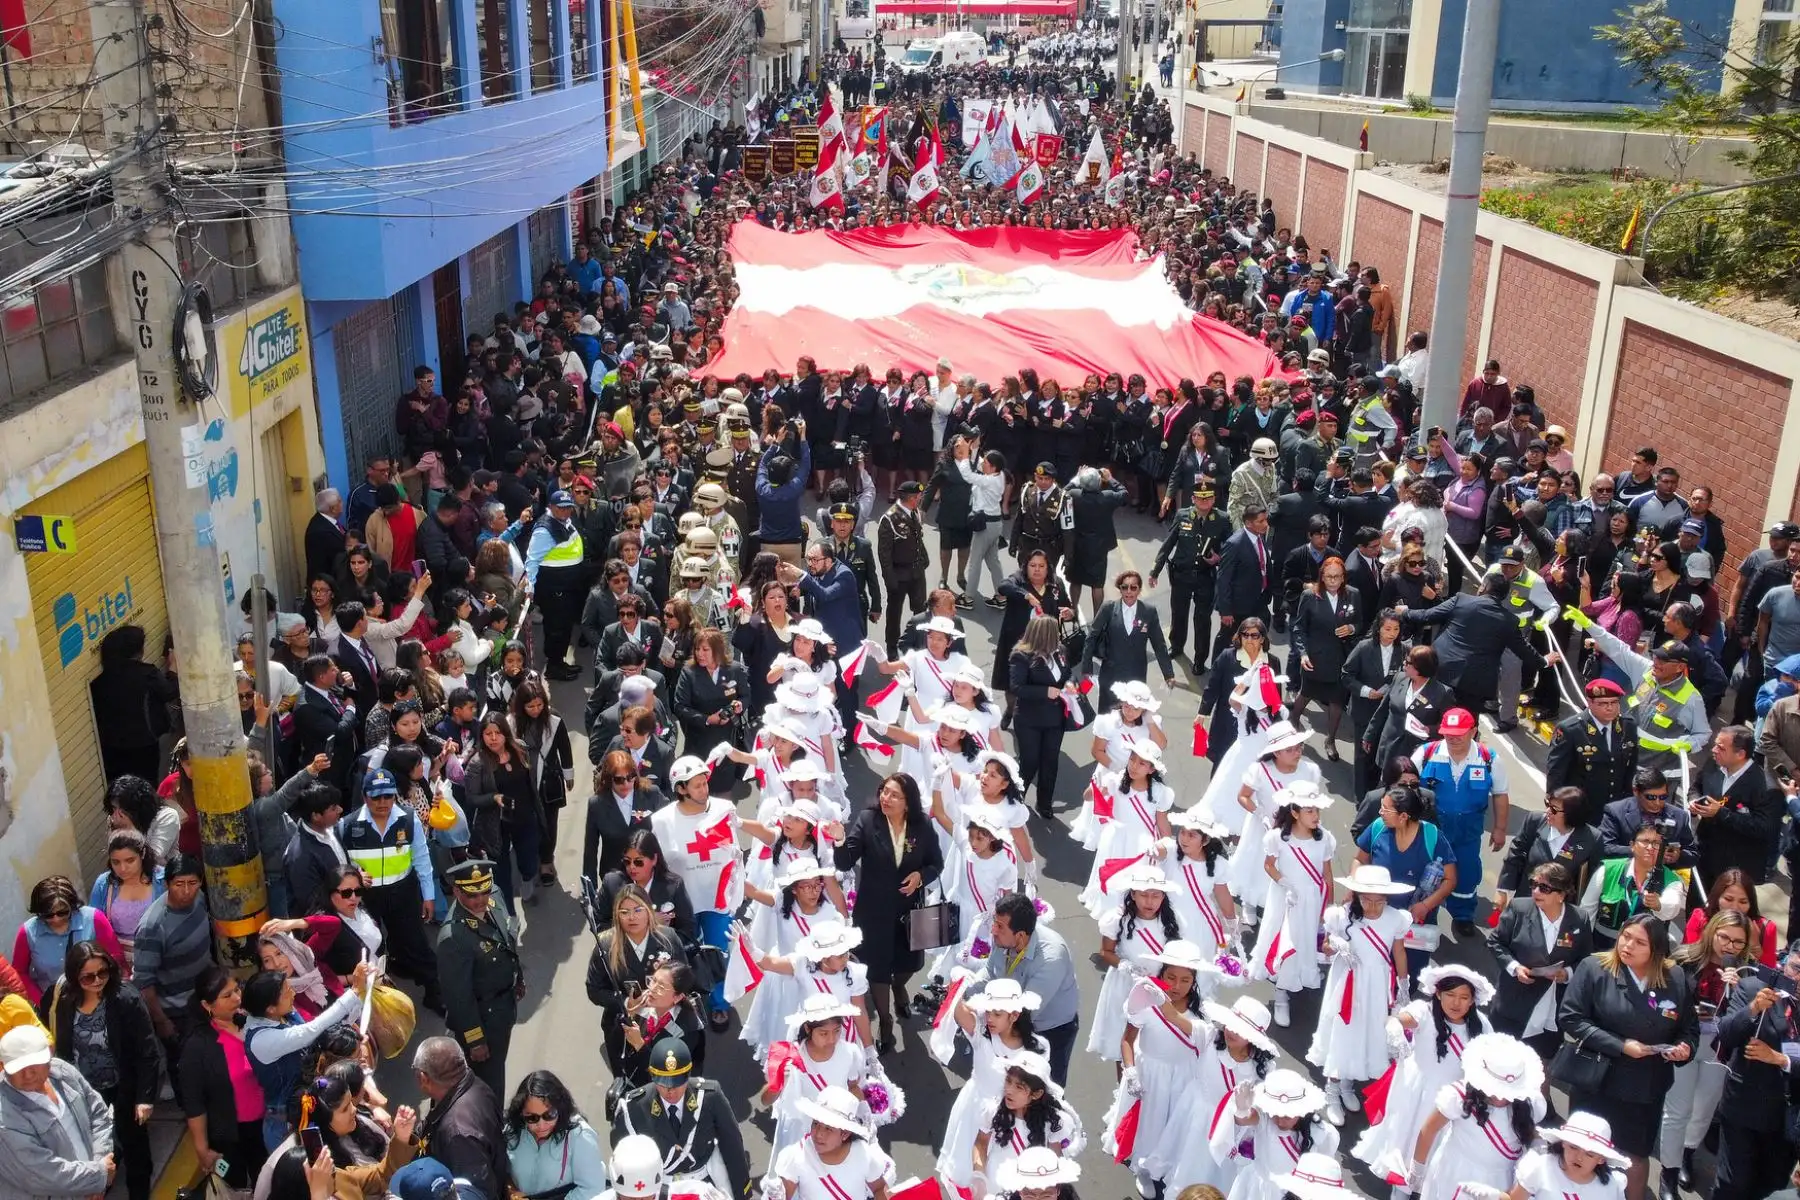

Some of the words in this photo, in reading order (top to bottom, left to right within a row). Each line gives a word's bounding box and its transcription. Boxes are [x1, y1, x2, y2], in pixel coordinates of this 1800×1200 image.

[267, 315, 282, 336] LTE
[240, 323, 269, 377] 4G
[268, 327, 295, 364] bitel
[143, 375, 158, 386] 12
[263, 377, 280, 396] PARA
[282, 363, 300, 384] TODOS
[84, 576, 132, 640] bitel
